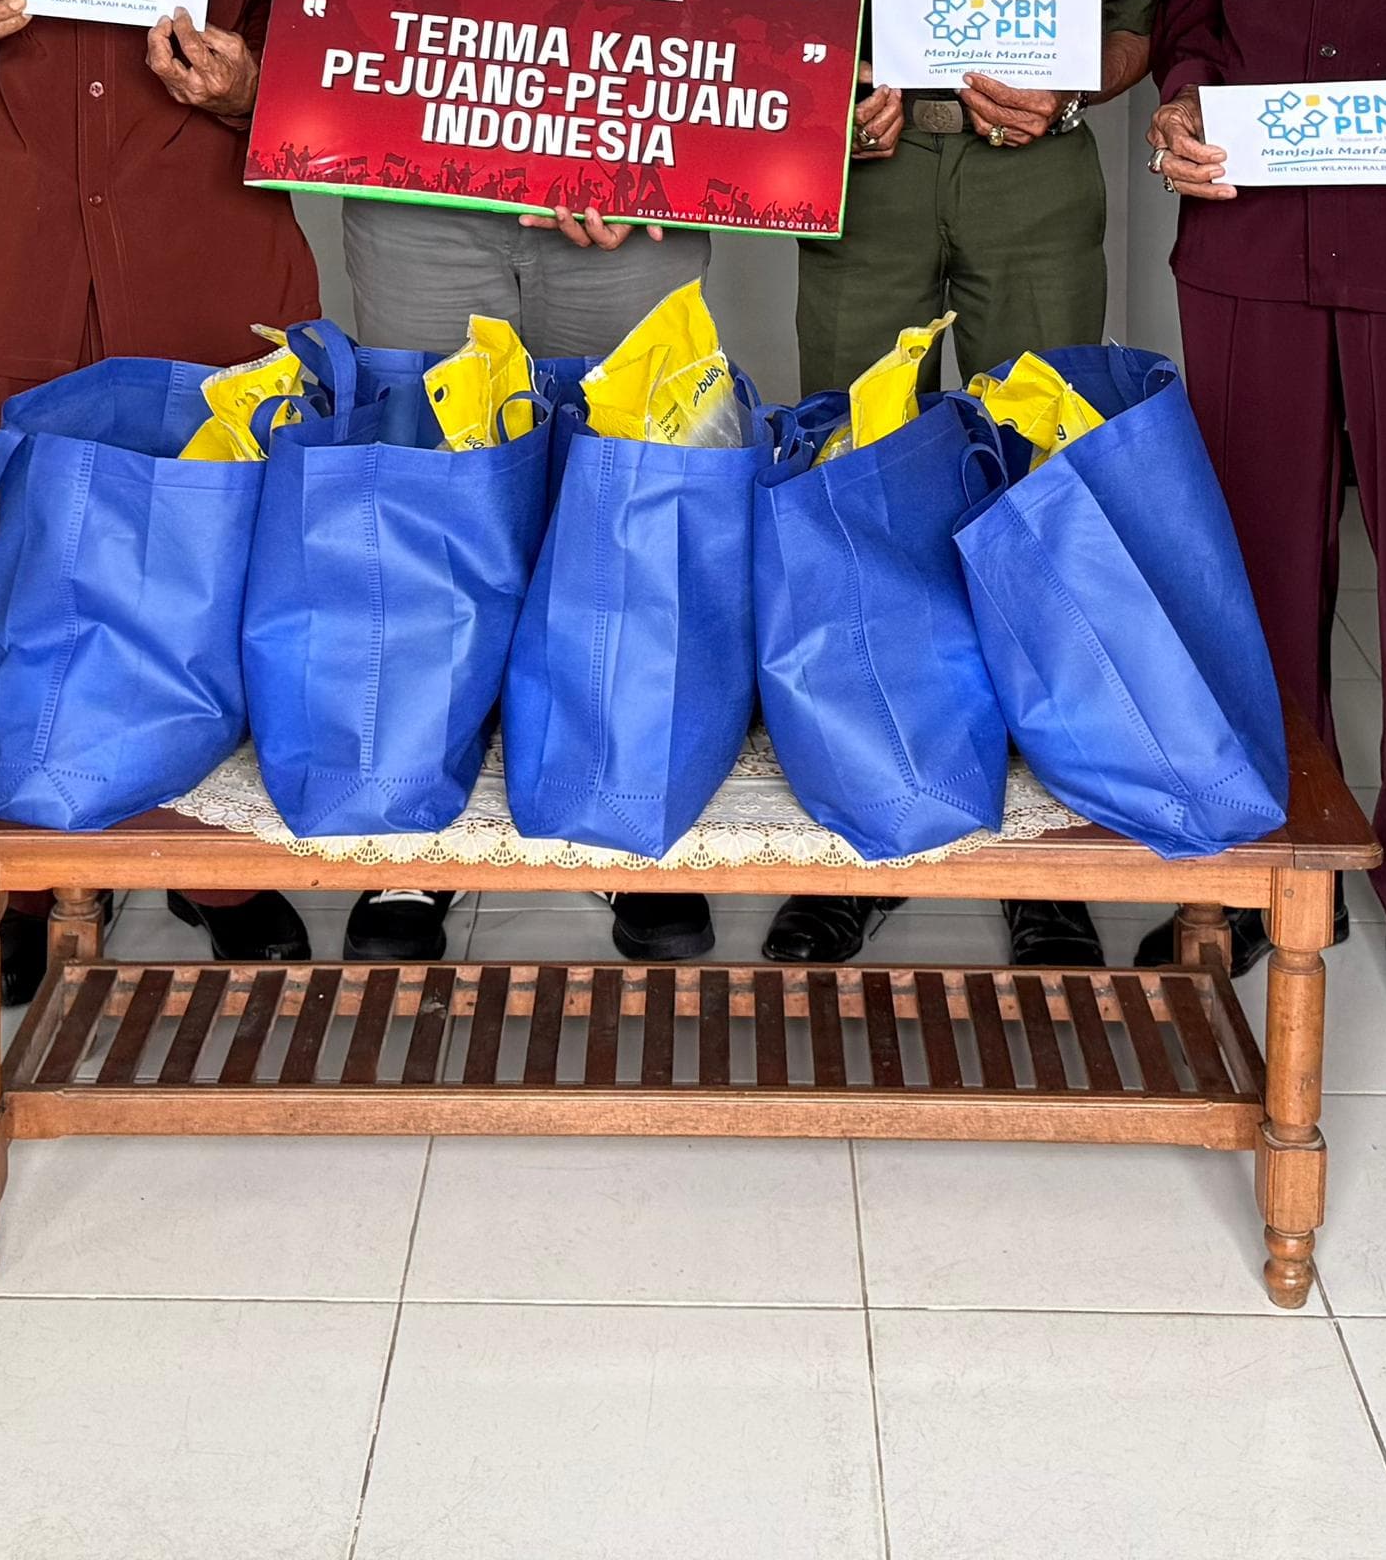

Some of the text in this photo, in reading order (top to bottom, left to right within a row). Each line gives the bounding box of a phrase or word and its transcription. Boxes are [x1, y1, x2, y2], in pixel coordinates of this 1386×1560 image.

[995, 19, 1057, 39] PLN
[390, 11, 570, 68] TERIMA
[589, 30, 736, 82] KASIH
[924, 48, 1058, 60] Menjejak Manfaat
[321, 48, 789, 131] PEJUANG-PEJUANG
[421, 101, 675, 167] INDONESIA
[1260, 146, 1334, 158] Menjejak
[636, 208, 829, 231] DIRGAHAYU REPUBLIK INDONESIA
[697, 365, 726, 394] bulog
